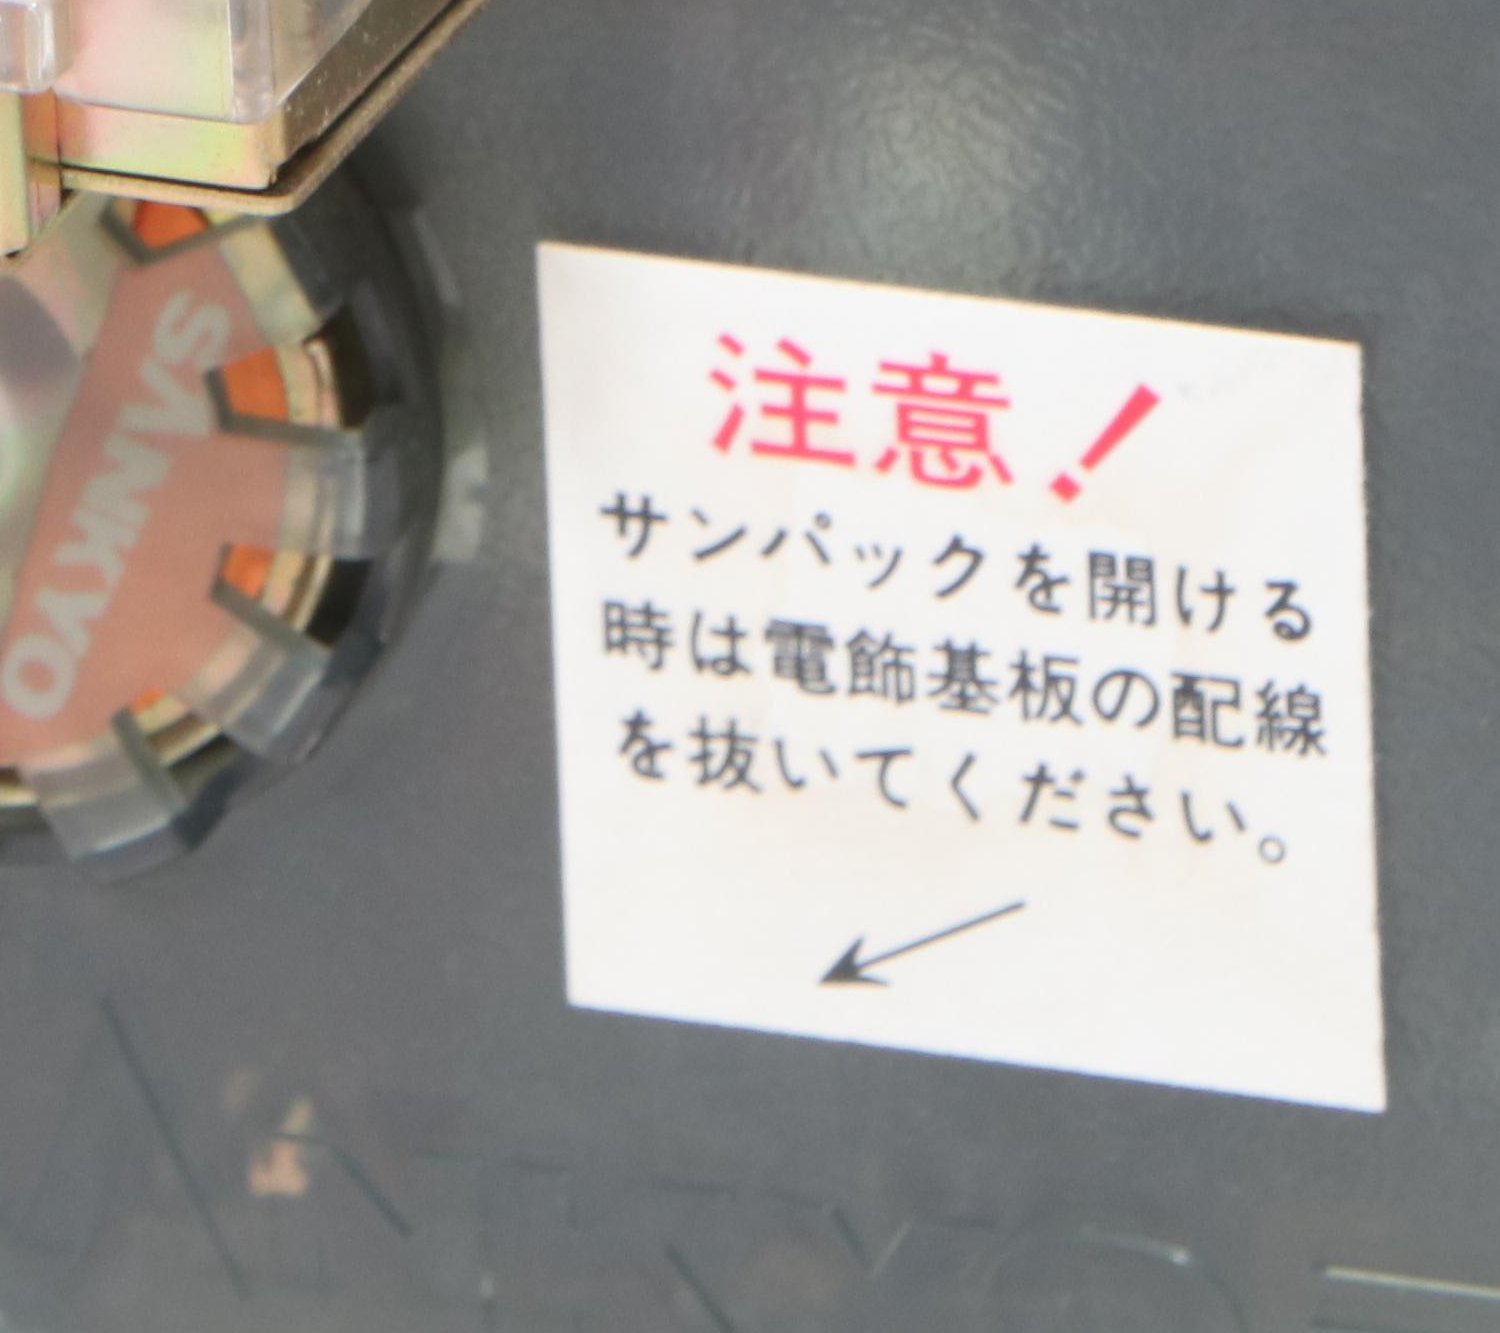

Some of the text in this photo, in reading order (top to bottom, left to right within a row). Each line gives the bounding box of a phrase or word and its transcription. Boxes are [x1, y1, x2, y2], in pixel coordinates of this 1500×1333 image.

[0, 288, 231, 720] SANKYO
[600, 492, 1314, 643] サンパックを開ける
[603, 599, 1329, 758] 時は電飾基板の配線
[619, 709, 1289, 866] を抜いてください。
